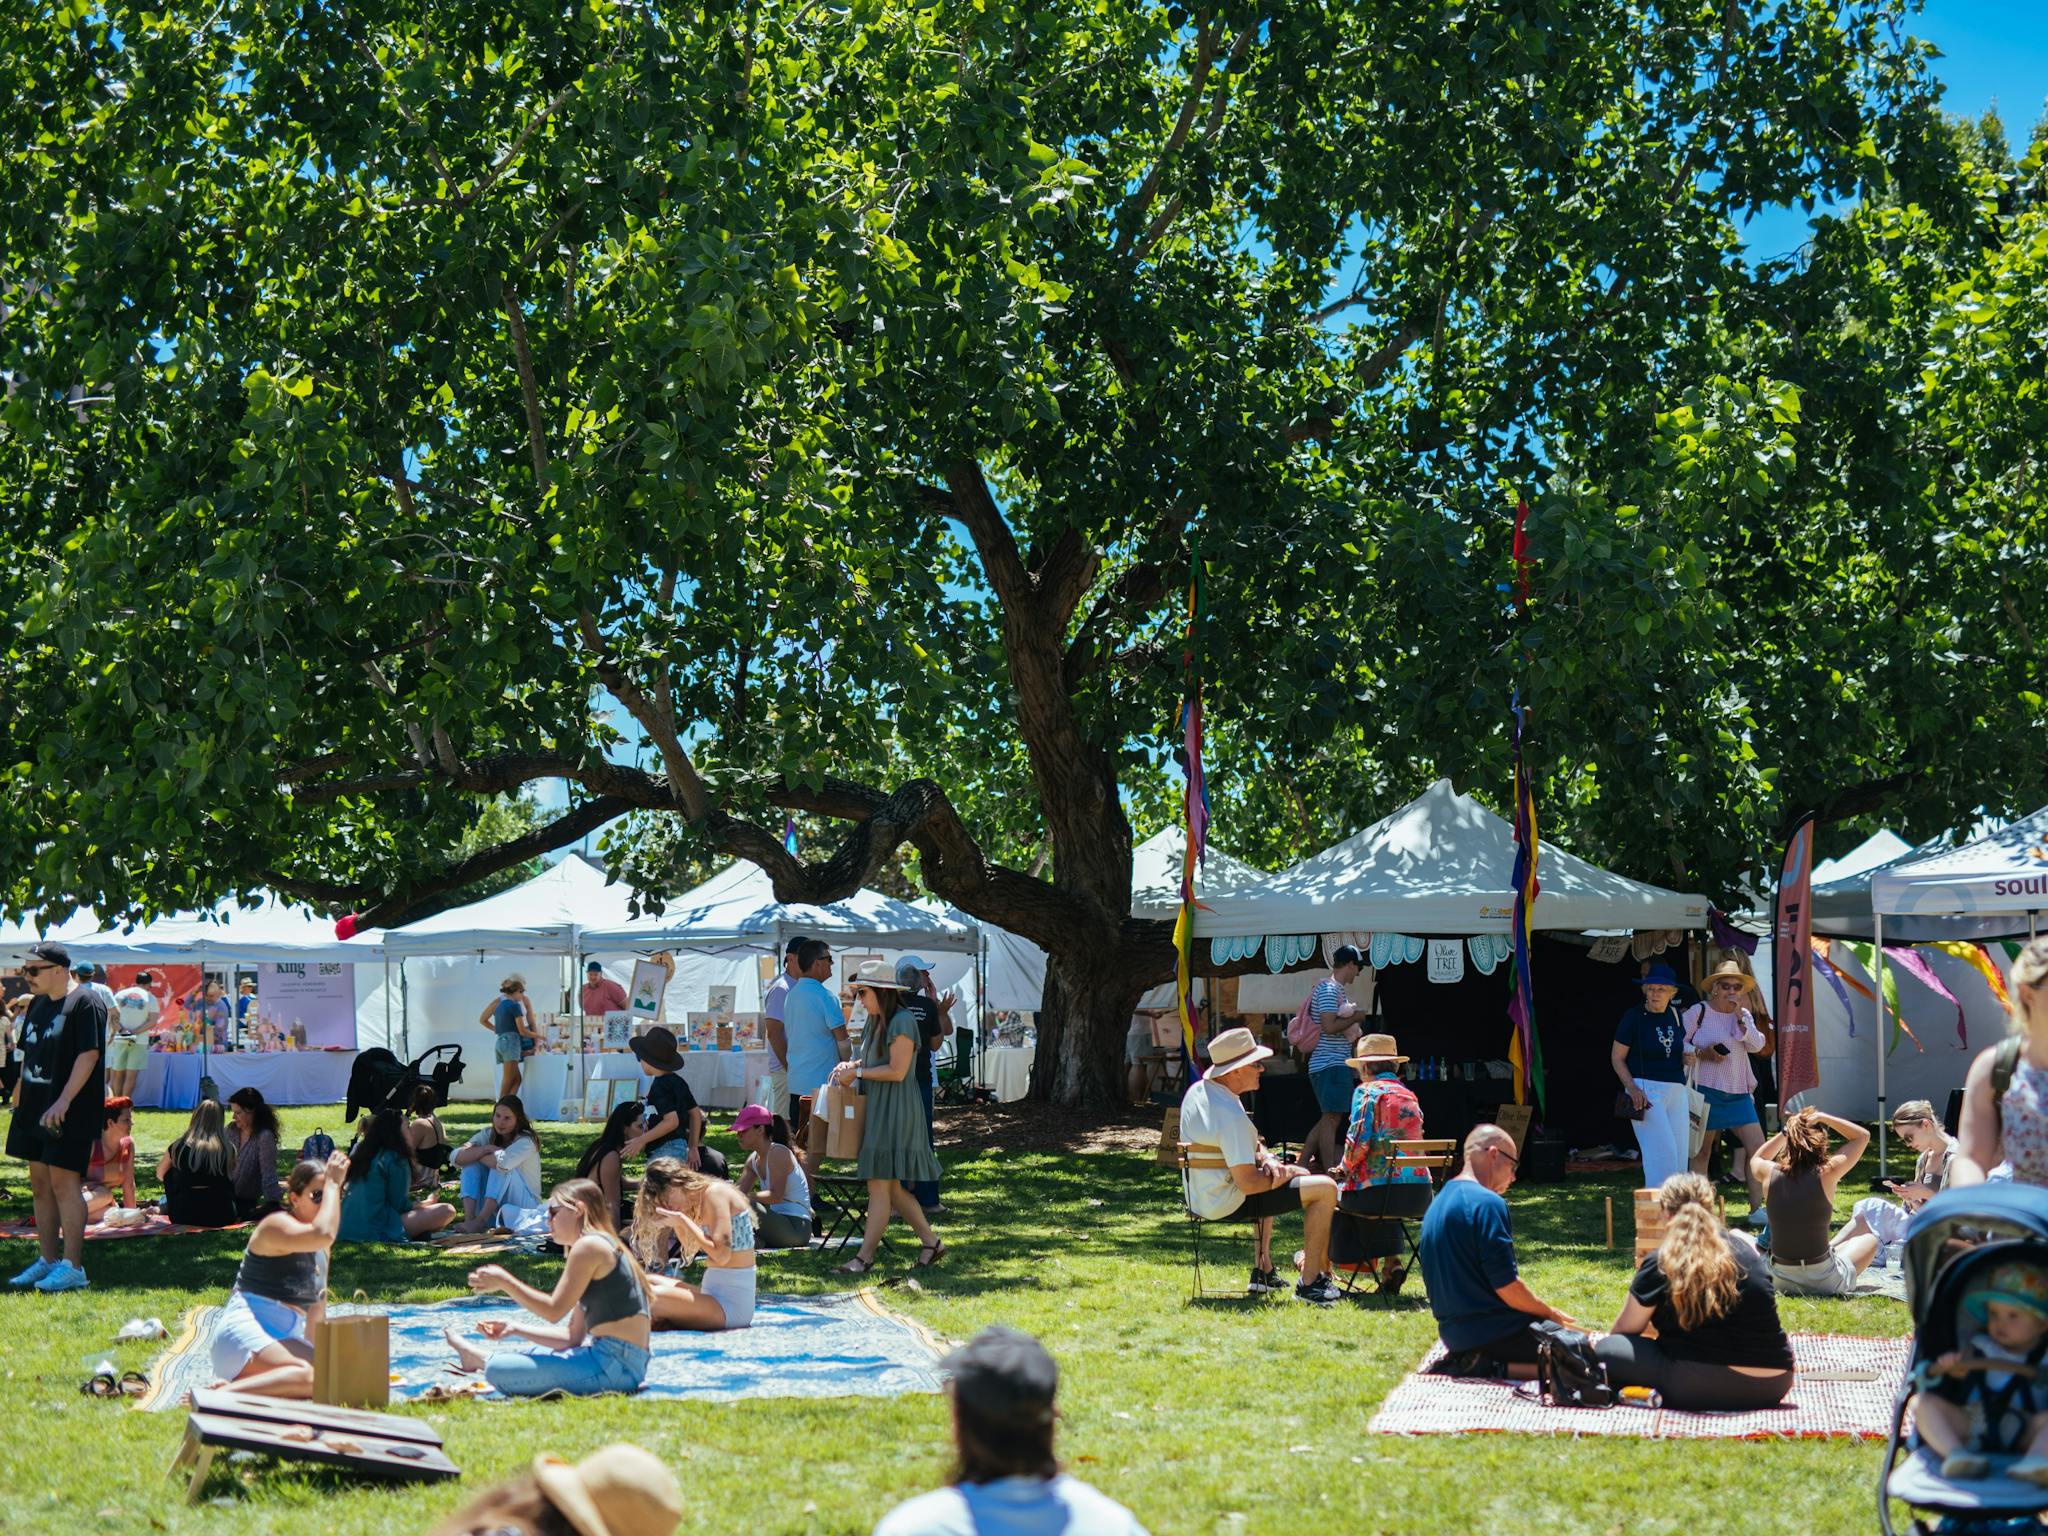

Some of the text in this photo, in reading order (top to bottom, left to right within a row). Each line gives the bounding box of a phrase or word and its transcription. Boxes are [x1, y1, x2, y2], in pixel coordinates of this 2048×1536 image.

[1994, 873, 2047, 896] soul
[1435, 943, 1457, 957] Olive
[1434, 957, 1457, 970] TREE
